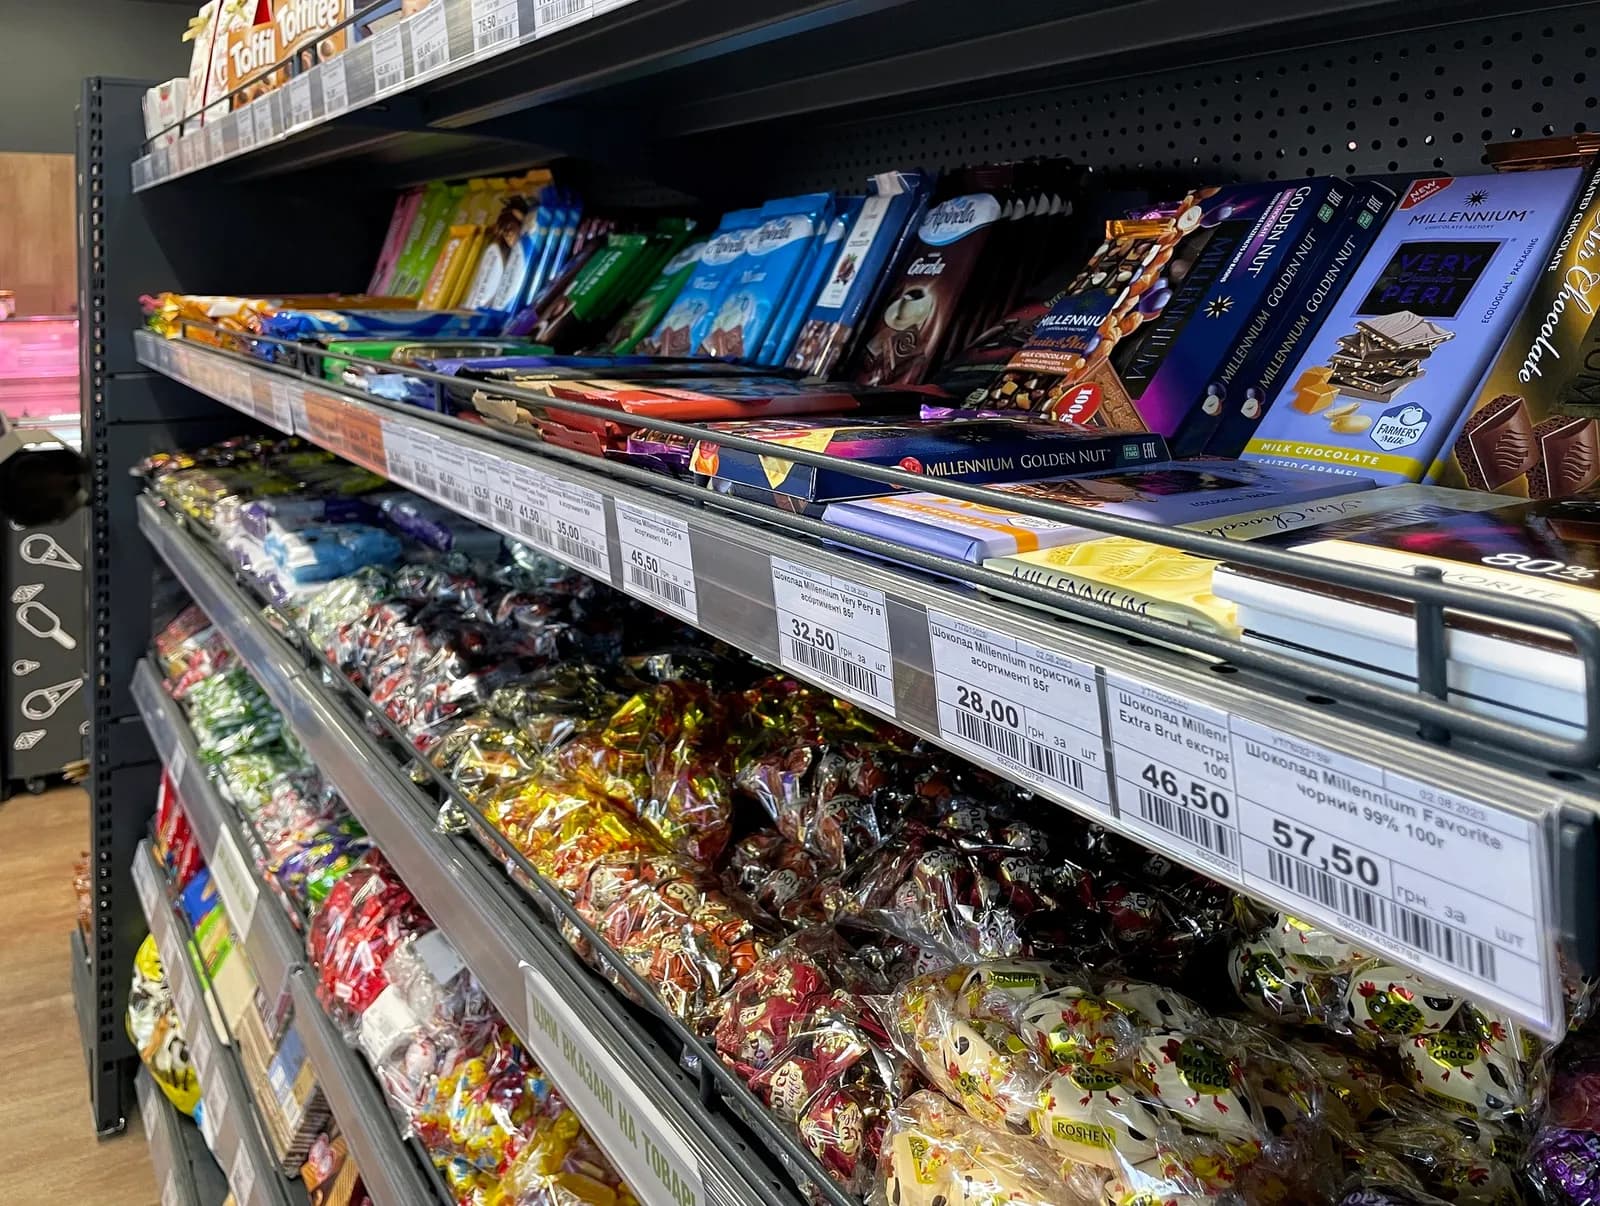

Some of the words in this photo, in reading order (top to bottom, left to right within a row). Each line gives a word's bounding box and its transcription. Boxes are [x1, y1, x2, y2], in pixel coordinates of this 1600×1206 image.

[1410, 180, 1437, 199] NEW
[1267, 186, 1312, 241] GOLDEN
[1408, 210, 1529, 226] MILLENNIUM
[1547, 211, 1583, 272] CHOCOLATE
[1247, 243, 1277, 279] NUT
[1400, 253, 1482, 272] VERY
[1380, 286, 1455, 304] PERI
[1480, 280, 1514, 325] ECOLOGICAL
[1510, 236, 1540, 277] PACKAGING
[1223, 309, 1271, 385] MILLENNIUM
[1267, 257, 1302, 308] GOLDEN
[1295, 231, 1317, 261] NUT
[1260, 314, 1310, 389] MILLENNIUM
[1306, 263, 1341, 313] GOLDEN
[1334, 237, 1357, 267] NUT
[1376, 423, 1421, 441] FARMERS
[926, 457, 1014, 477] MILLENNIUM
[1020, 452, 1077, 469] GOLDEN
[1079, 449, 1107, 464] NUT
[1261, 442, 1292, 455] MILK
[1295, 445, 1380, 466] CHOCOLATE
[556, 519, 580, 541] 35,00
[631, 548, 659, 574] 45,50
[1481, 553, 1598, 581] 80%
[773, 568, 803, 588] Шоколад
[803, 579, 840, 601] Millennium
[840, 592, 857, 609] Very
[857, 601, 875, 617] Pery
[800, 592, 842, 615] асортименті
[842, 606, 855, 620] 85г
[791, 617, 836, 652] 32,50
[875, 661, 887, 673] шт
[931, 624, 974, 652] Шоколад
[974, 640, 1028, 671] Millennium
[1028, 663, 1082, 691] пористий
[970, 655, 1031, 686] асортименті
[1032, 677, 1050, 694] 85г
[956, 685, 1020, 730] 28,00
[1118, 691, 1180, 727] Шоколад
[1119, 709, 1152, 732] Extra
[1154, 723, 1184, 745] Brut
[1053, 735, 1067, 749] за
[1081, 747, 1098, 762] шт
[1203, 761, 1228, 780] 100
[1141, 763, 1230, 820] 46,50
[1244, 741, 1320, 782] Шоколад
[1322, 770, 1418, 819] Millennium
[1423, 808, 1503, 851] Favorite
[1296, 781, 1359, 817] чорний
[1363, 806, 1400, 834] 99%
[1404, 822, 1446, 850] 100г
[1272, 818, 1380, 888] 57,50
[1444, 904, 1468, 926] за
[1494, 926, 1526, 948] шт
[1430, 1038, 1475, 1049] KO-KO
[1433, 1050, 1475, 1060] CHOCO
[561, 1032, 615, 1120] ВКАЗАНІ
[617, 1101, 639, 1150] НА
[1057, 1121, 1113, 1143] ROSHEN
